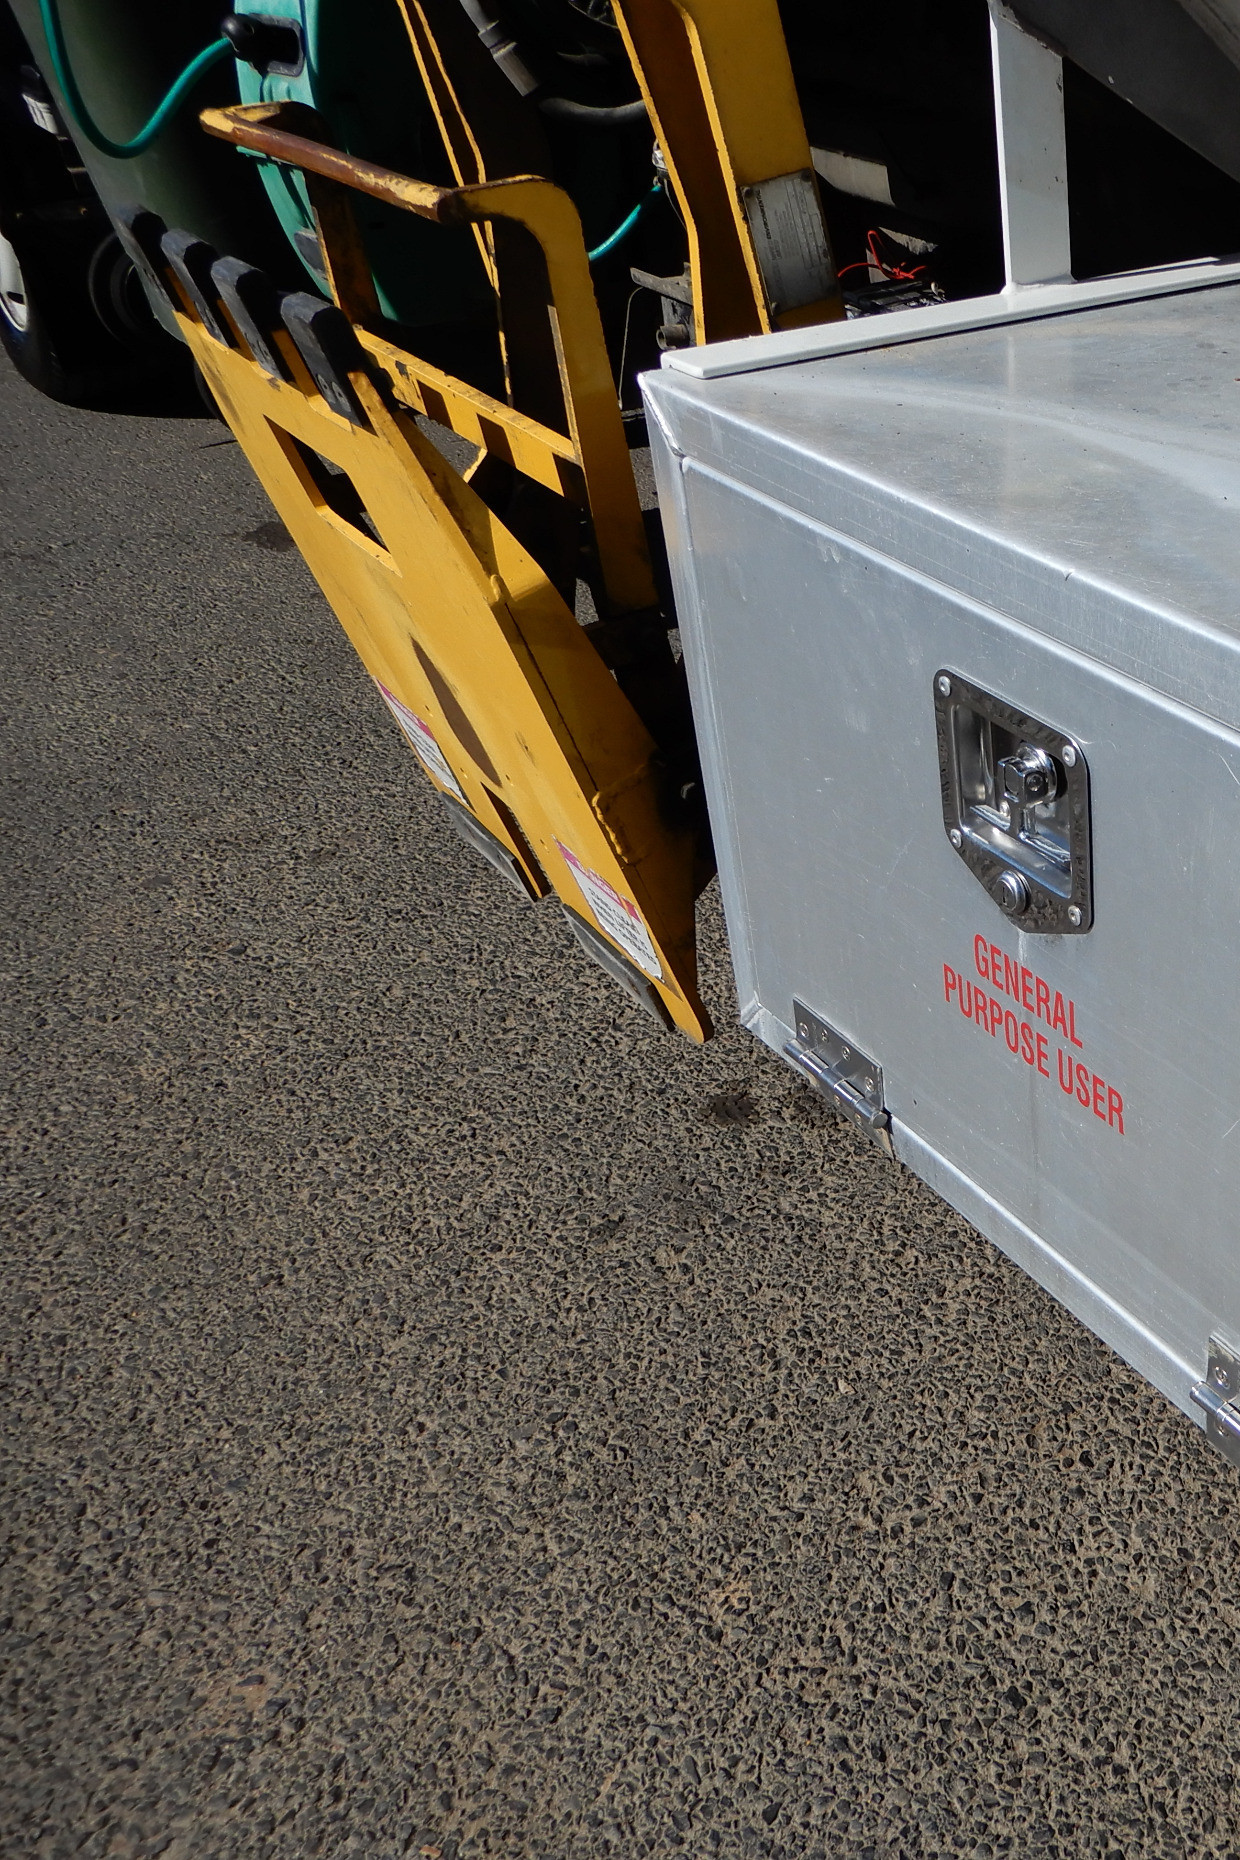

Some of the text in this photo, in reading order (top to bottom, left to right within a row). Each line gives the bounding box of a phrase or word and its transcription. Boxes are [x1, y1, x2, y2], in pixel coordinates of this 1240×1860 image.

[943, 963, 1125, 1136] PURPOSE USER
[973, 934, 1083, 1049] GENERAL
